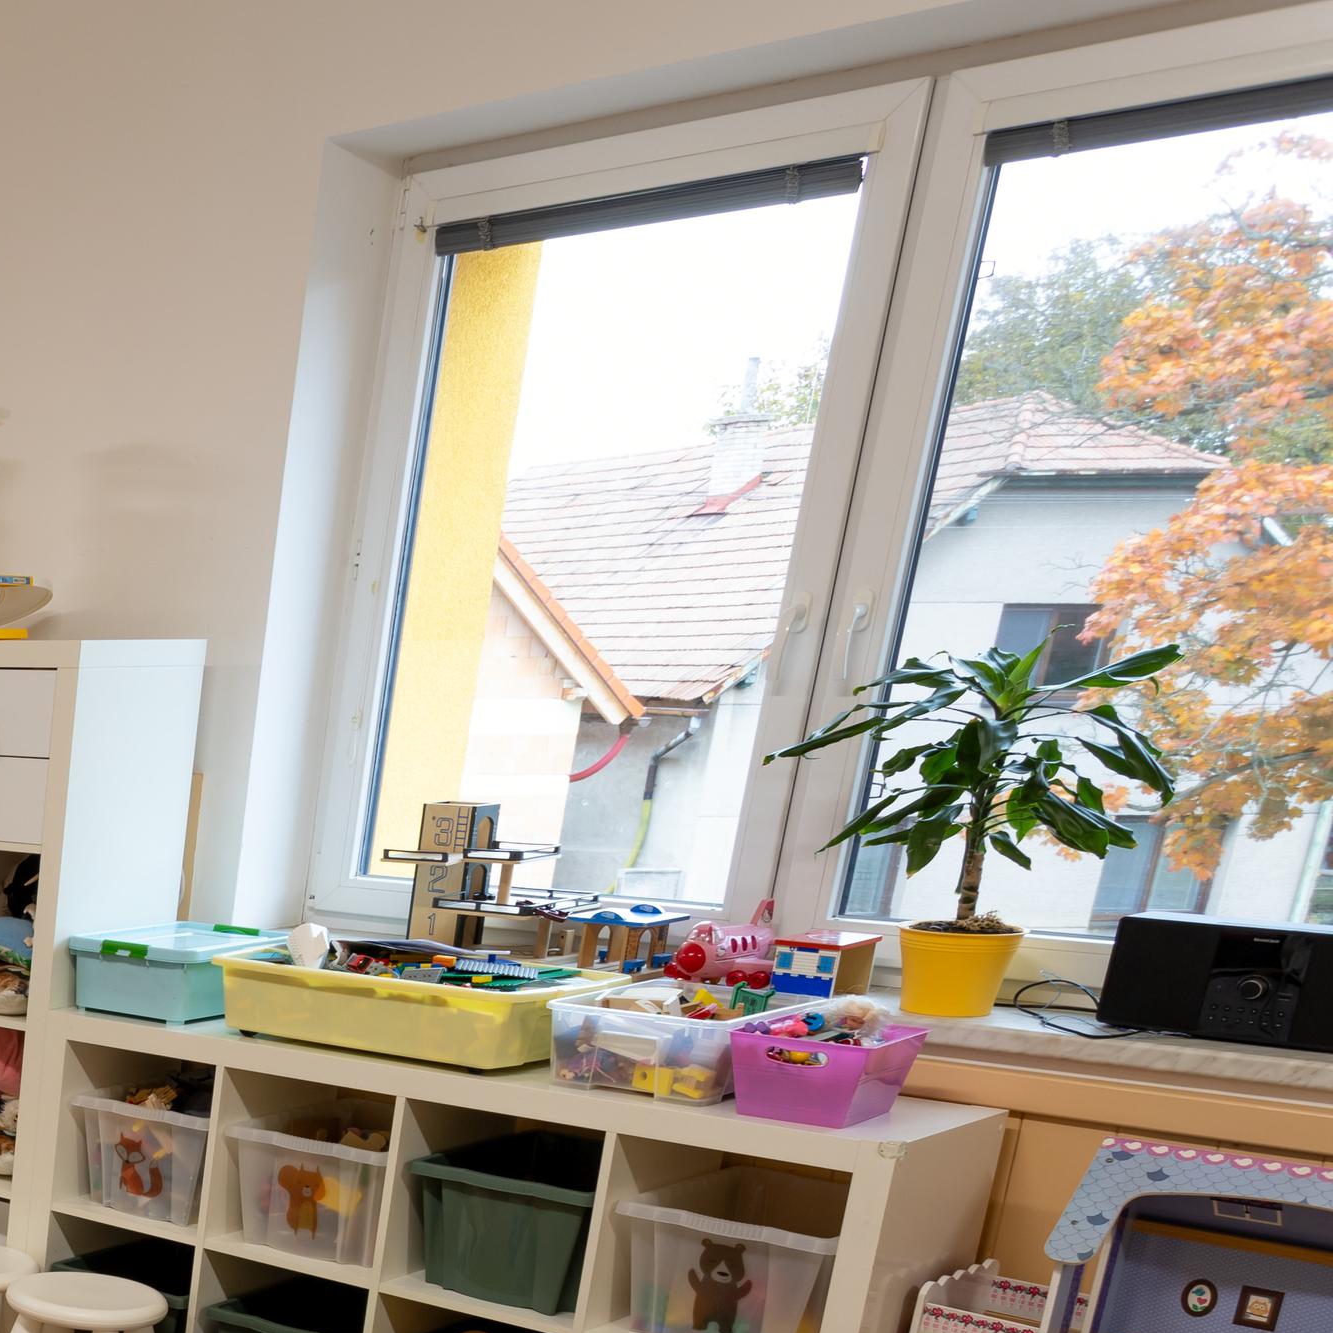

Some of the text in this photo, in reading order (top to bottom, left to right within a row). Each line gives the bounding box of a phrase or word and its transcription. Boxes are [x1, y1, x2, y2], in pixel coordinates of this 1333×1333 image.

[434, 816, 454, 847] 3
[428, 864, 448, 893] 2
[427, 912, 436, 936] 1
